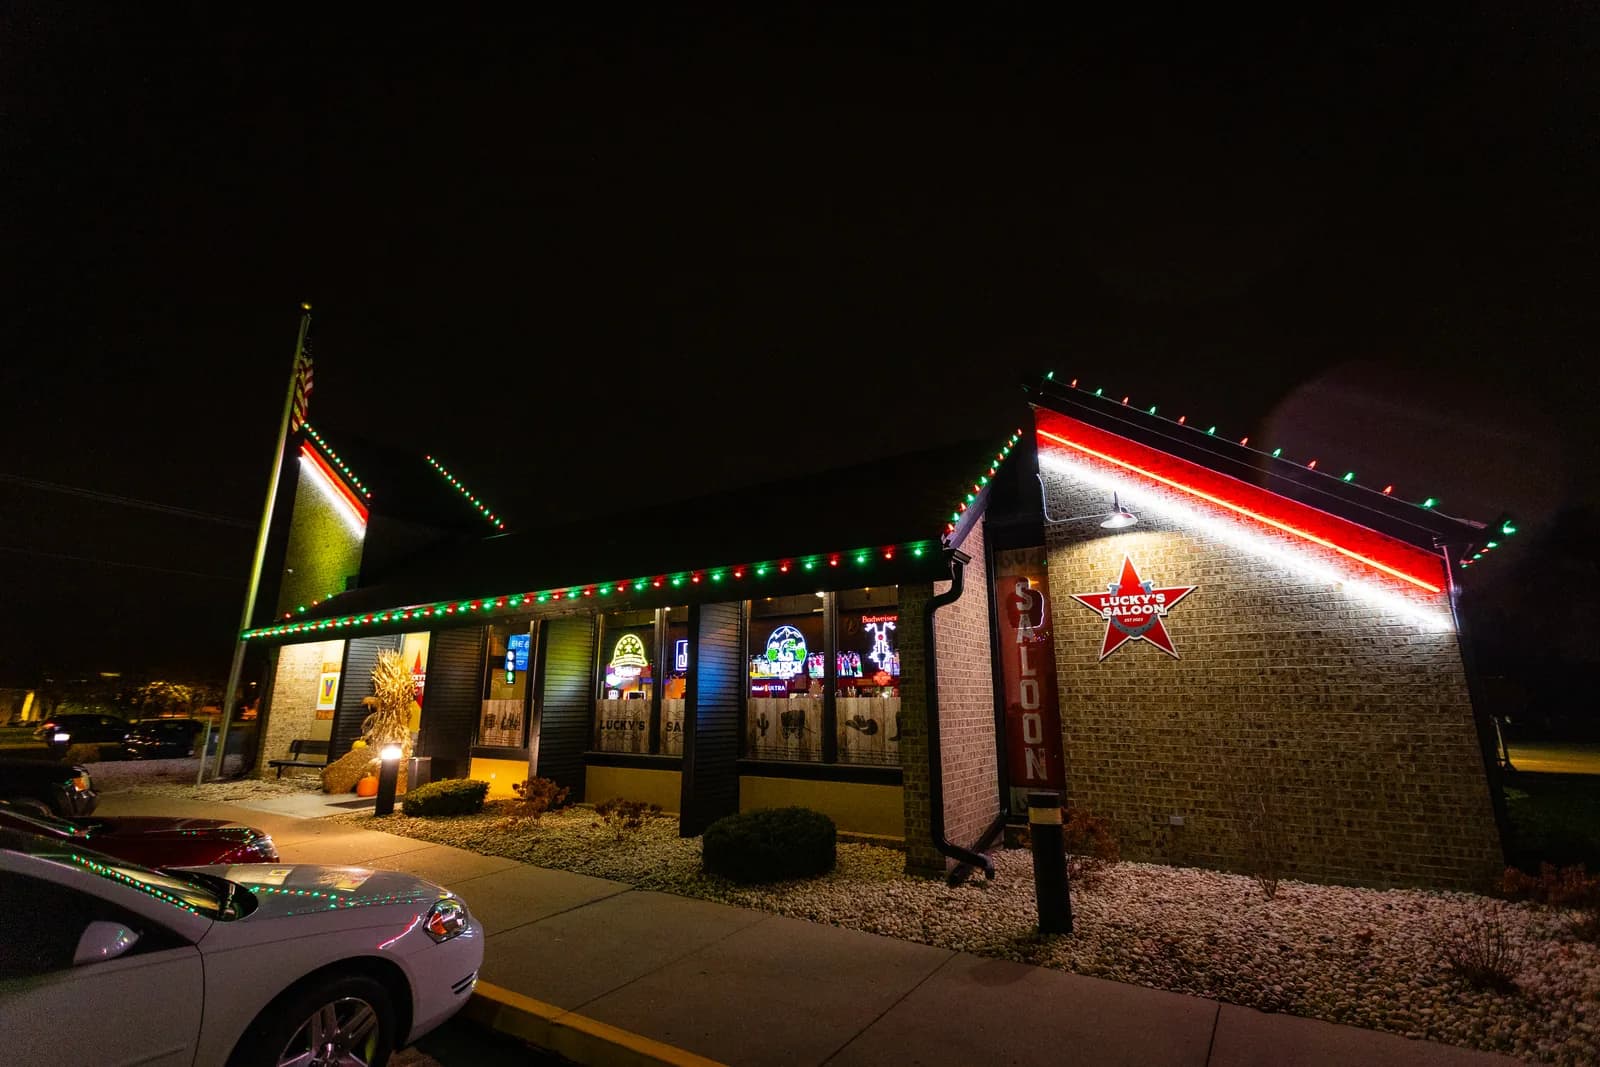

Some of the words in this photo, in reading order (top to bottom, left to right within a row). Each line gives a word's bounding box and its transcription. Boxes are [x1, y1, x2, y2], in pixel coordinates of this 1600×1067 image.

[1100, 593, 1166, 607] LUCKY'S
[1102, 604, 1166, 618] SALOON
[862, 615, 898, 624] Budweiser
[1016, 577, 1047, 780] SALOON
[600, 720, 645, 731] LUCKY'S
[666, 721, 685, 733] SA
